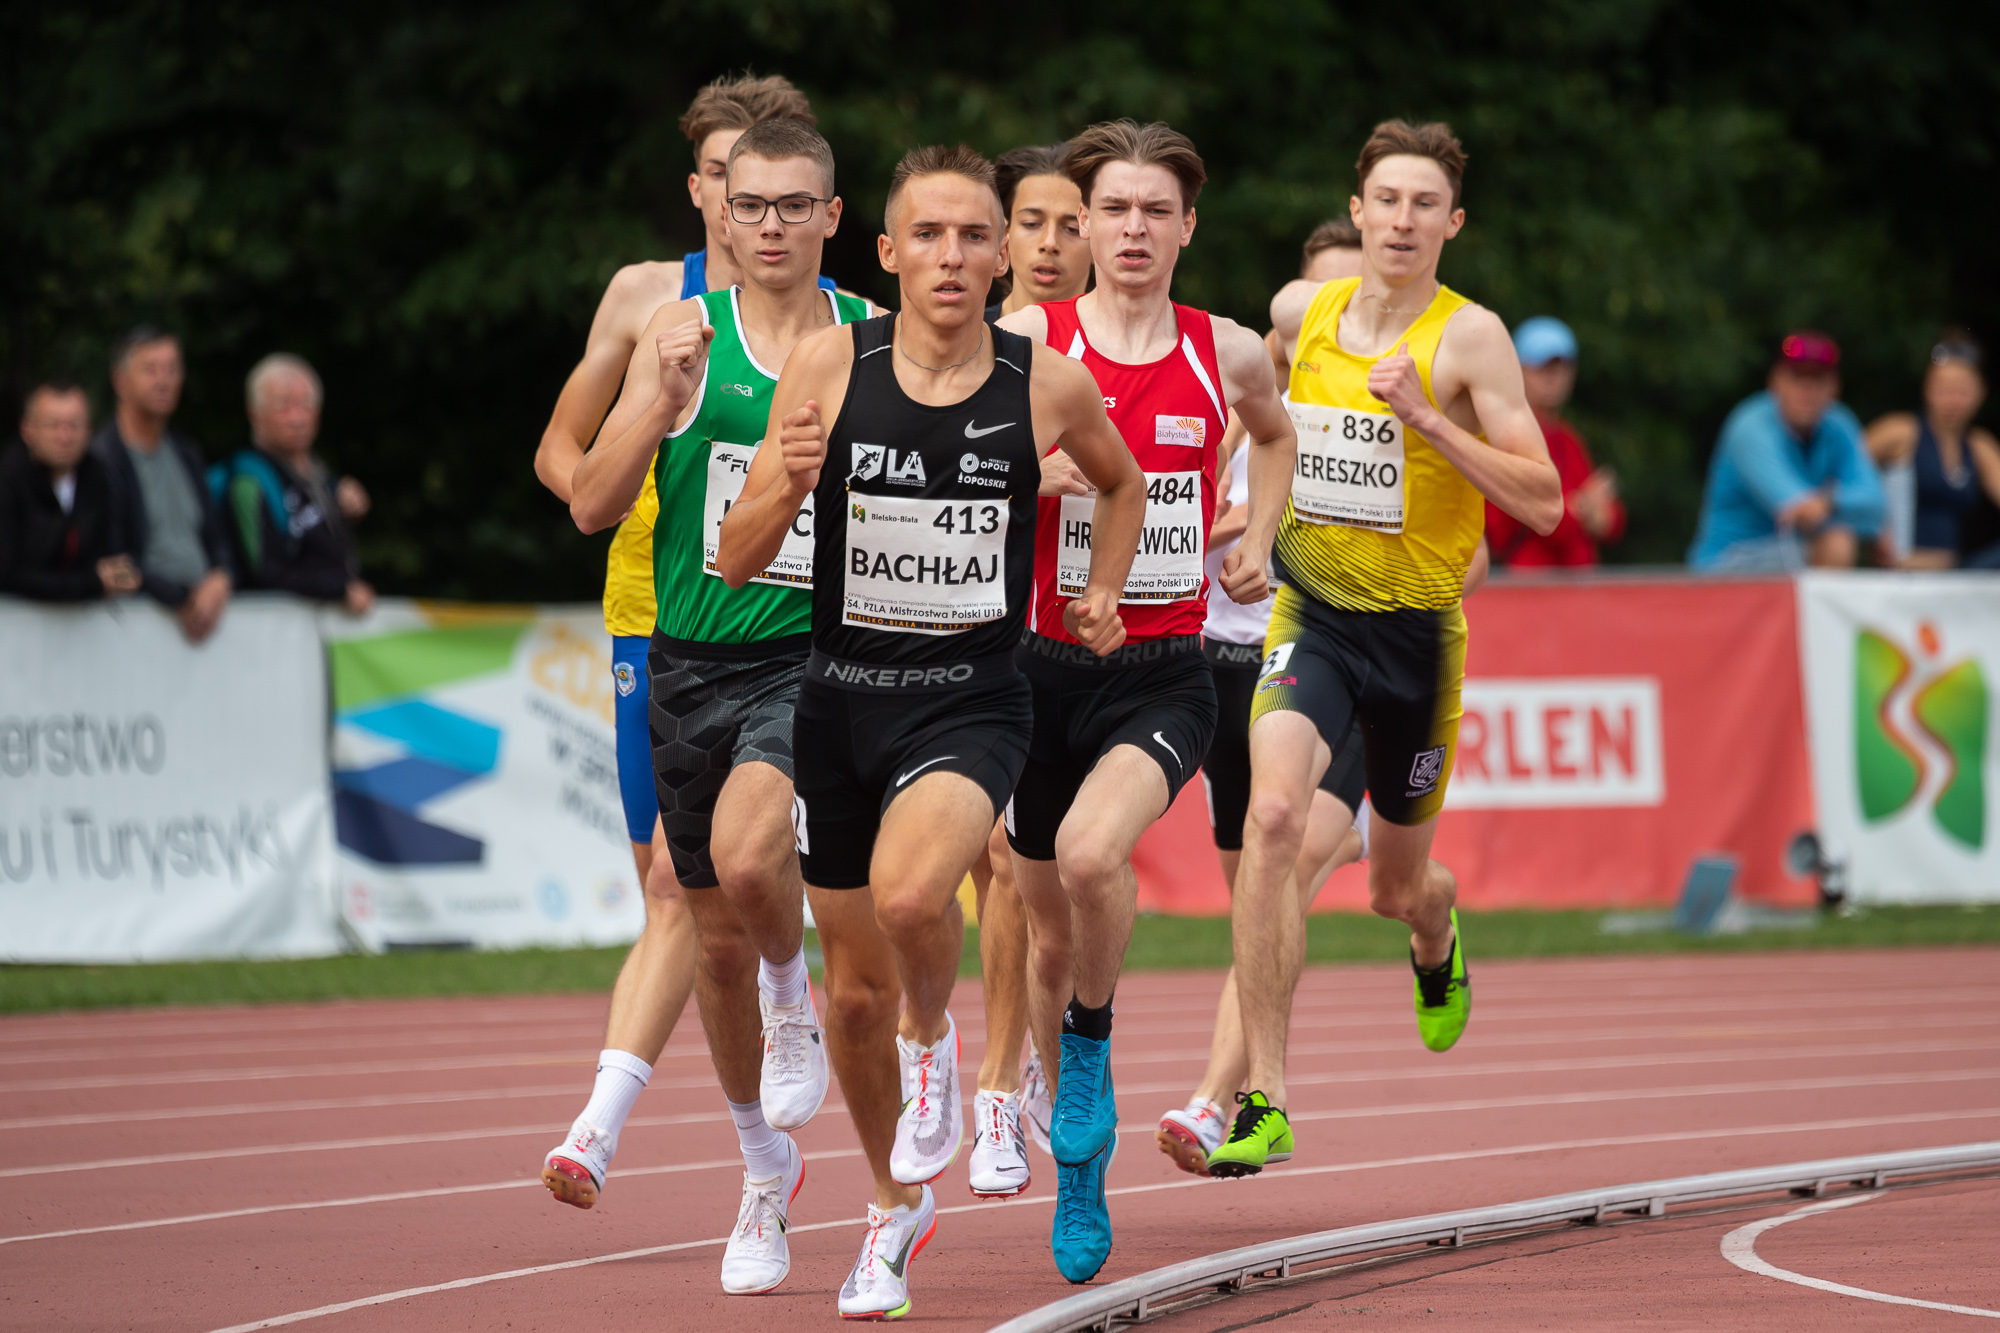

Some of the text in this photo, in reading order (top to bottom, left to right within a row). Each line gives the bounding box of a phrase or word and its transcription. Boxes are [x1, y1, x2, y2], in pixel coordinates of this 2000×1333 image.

[1343, 415, 1395, 444] 836
[980, 461, 1010, 472] OPOLE
[963, 476, 1007, 489] OPOLSKIE
[1147, 477, 1194, 505] 484
[871, 513, 918, 523] Bielsko-Biała
[932, 505, 999, 535] 413
[1360, 508, 1383, 518] Polski
[1386, 510, 1402, 518] U18
[851, 546, 998, 585] BACHŁAJ
[1157, 579, 1181, 588] Polski
[1184, 578, 1201, 587] U18
[847, 599, 1003, 619] 54. PZLA Mistrzostwa Polski U18
[861, 595, 897, 604] Ogólnopolska
[848, 613, 916, 628] BIELSKO-BIAŁA
[1032, 637, 1094, 666] NIKE
[1100, 641, 1161, 667] PRO
[1216, 643, 1263, 665] NIK
[824, 661, 974, 687] NIKE PRO
[1455, 707, 1634, 782] RLEN
